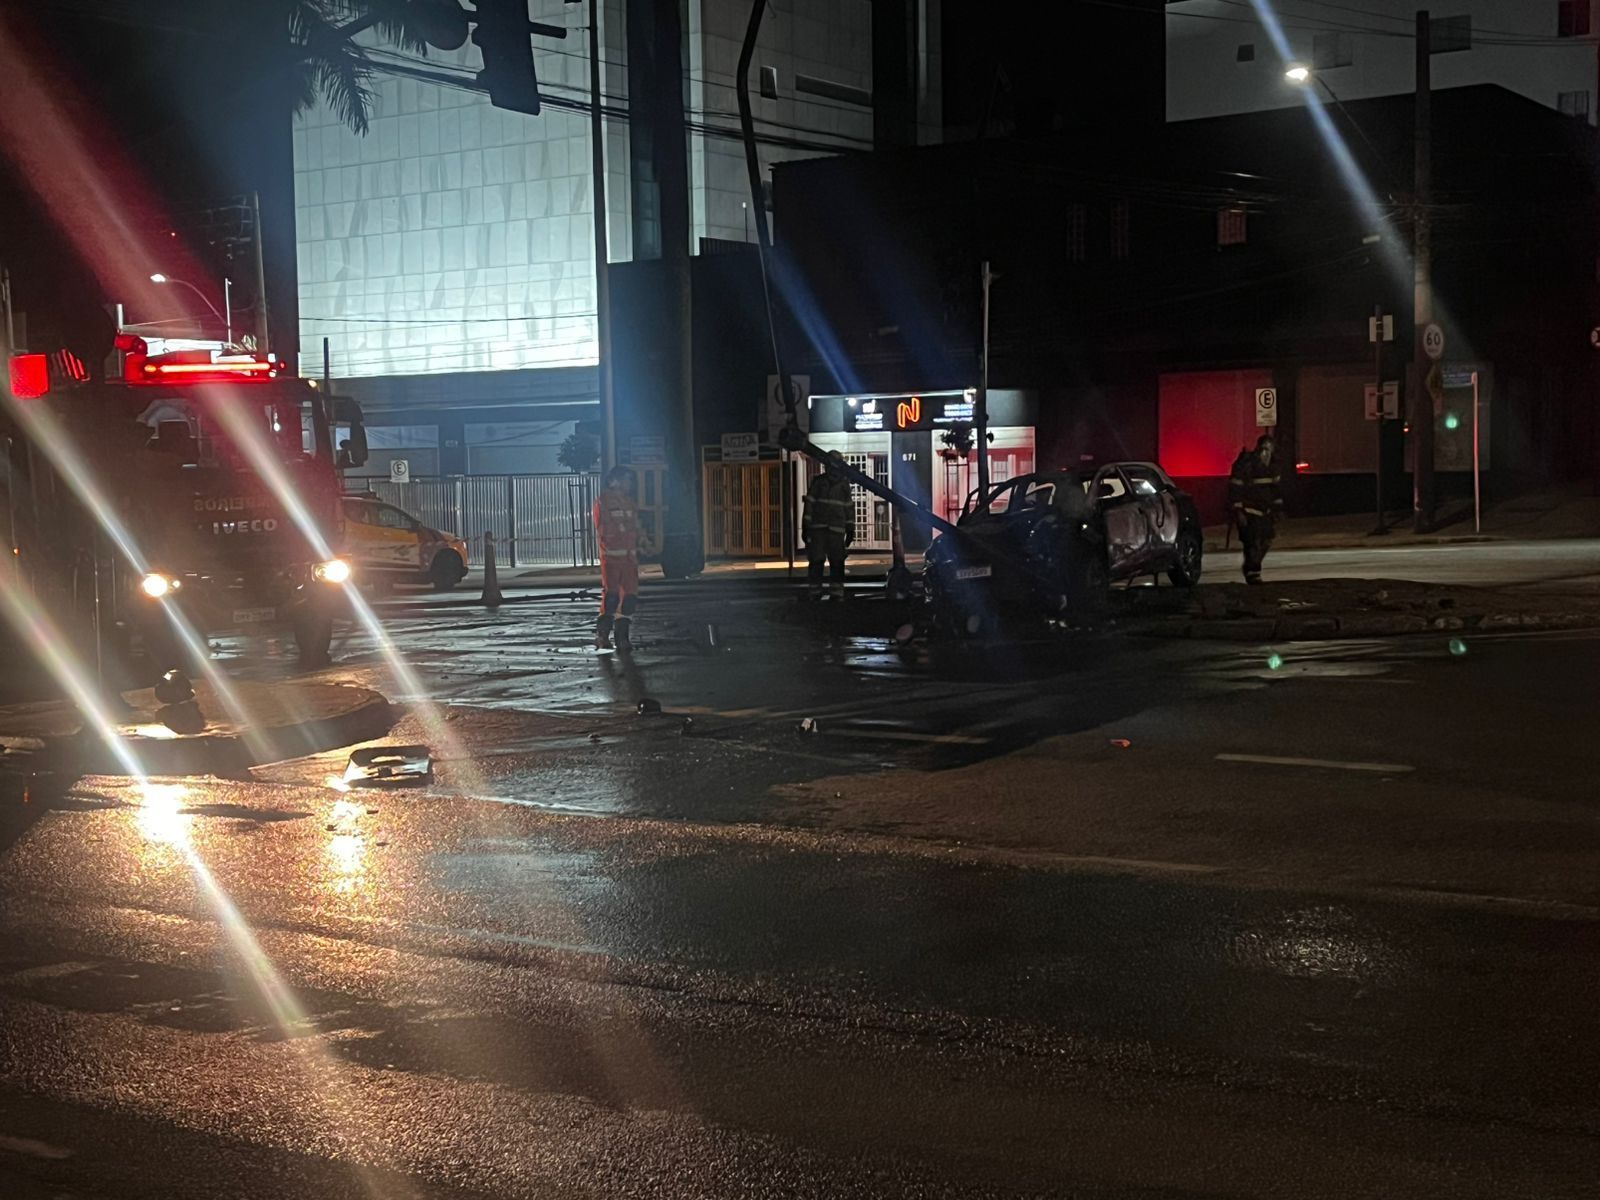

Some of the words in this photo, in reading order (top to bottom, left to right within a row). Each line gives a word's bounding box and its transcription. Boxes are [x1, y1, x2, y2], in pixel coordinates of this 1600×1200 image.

[1426, 332, 1441, 346] 60
[1264, 392, 1271, 405] E
[897, 397, 921, 428] N
[212, 518, 278, 535] IVECO
